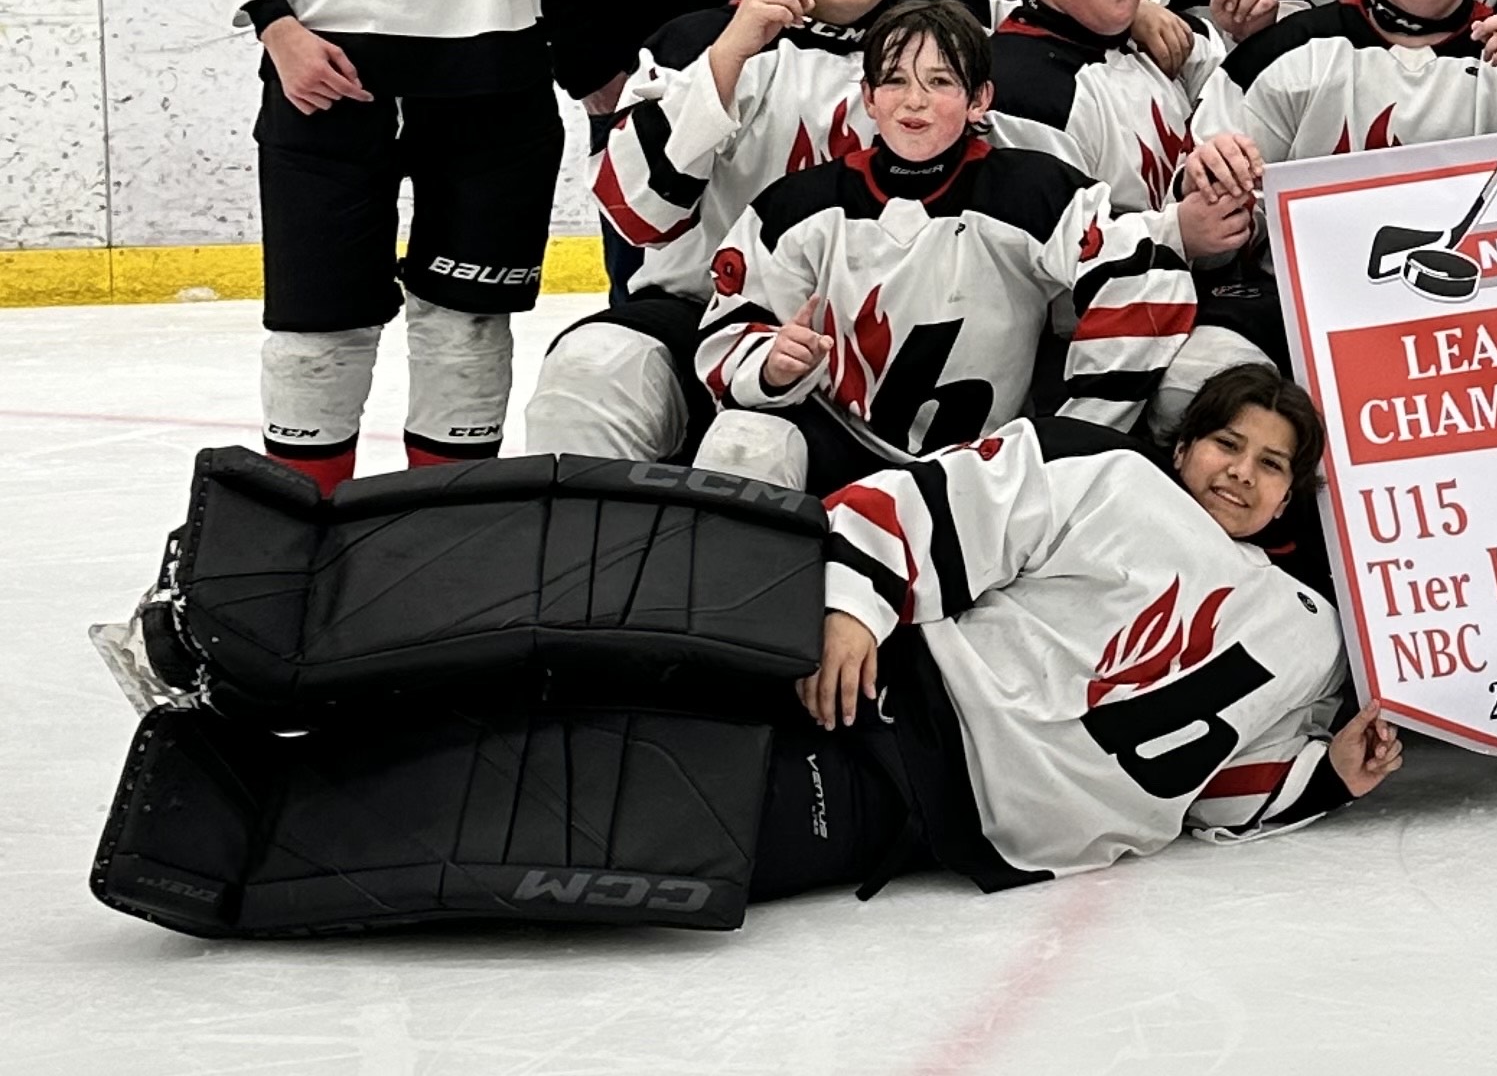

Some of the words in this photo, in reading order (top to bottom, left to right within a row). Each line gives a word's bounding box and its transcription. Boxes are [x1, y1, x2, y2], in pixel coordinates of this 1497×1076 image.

[428, 256, 542, 286] BAUER
[268, 423, 320, 438] CCM
[627, 463, 806, 514] CCM
[1359, 479, 1468, 545] U15
[1367, 559, 1469, 618] Tier
[1389, 625, 1488, 683] NBC
[512, 870, 713, 914] CCM
